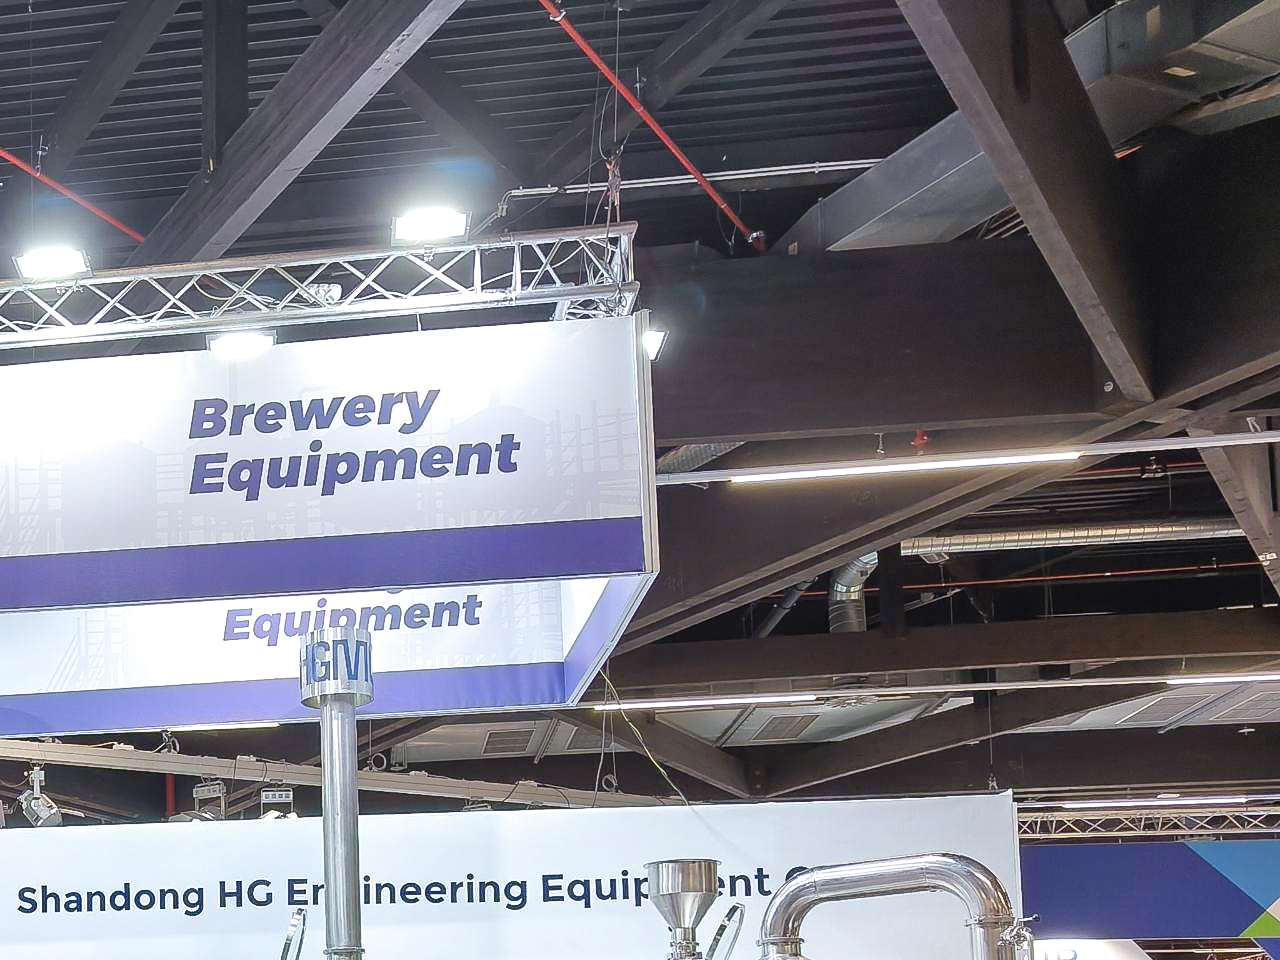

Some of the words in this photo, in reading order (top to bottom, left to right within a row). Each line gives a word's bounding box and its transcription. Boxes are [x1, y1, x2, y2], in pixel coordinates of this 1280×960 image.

[189, 389, 440, 439] Brewery
[189, 434, 520, 501] Equipment
[17, 882, 204, 917] Shandong
[219, 879, 274, 908] HG
[542, 867, 773, 909] Equipnt
